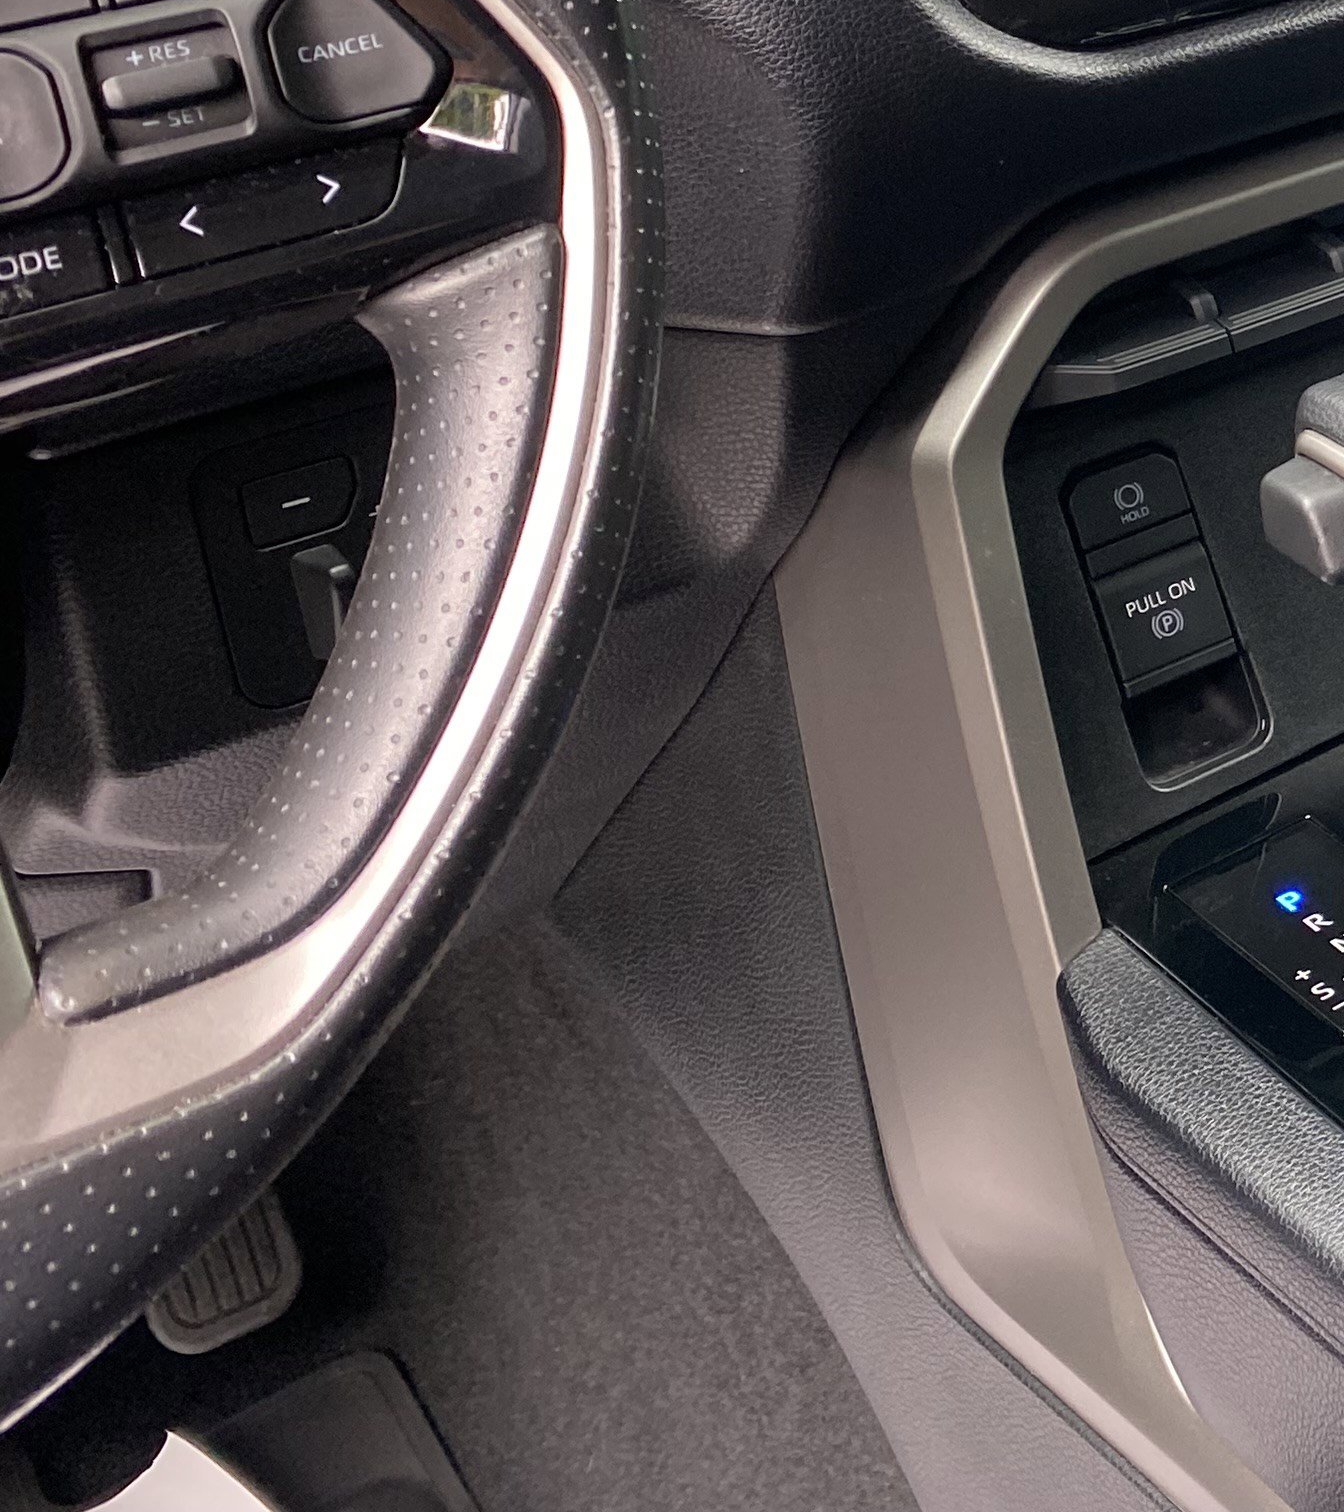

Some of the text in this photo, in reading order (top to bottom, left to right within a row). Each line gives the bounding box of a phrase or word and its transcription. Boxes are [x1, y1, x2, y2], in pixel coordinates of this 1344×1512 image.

[149, 40, 191, 63] RES
[297, 33, 384, 63] CANCEL
[167, 108, 205, 128] SET
[1120, 506, 1150, 524] HOLD
[1125, 577, 1196, 618] PULL ON
[1275, 891, 1301, 913] P
[1302, 913, 1334, 932] R
